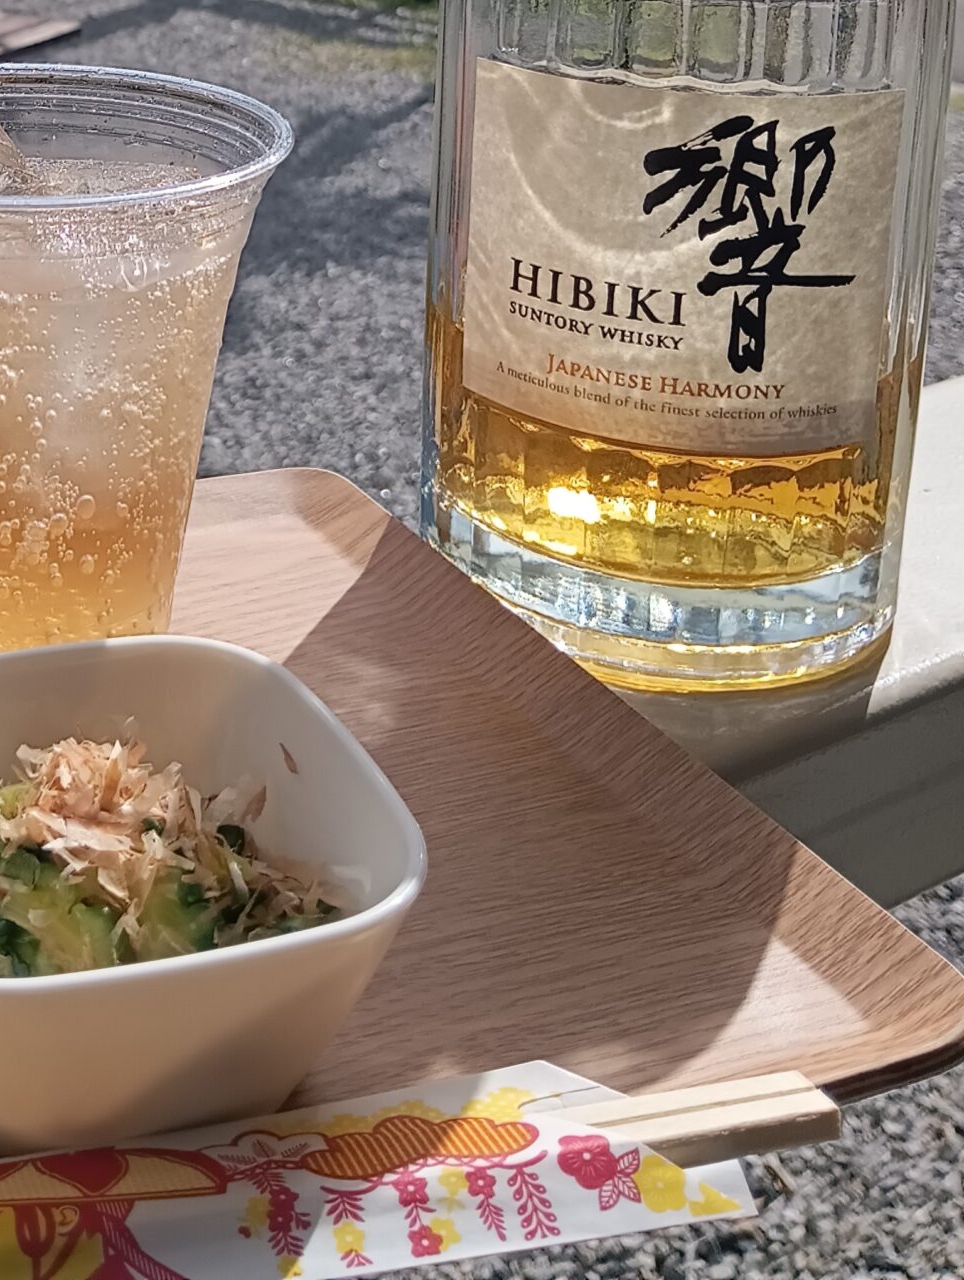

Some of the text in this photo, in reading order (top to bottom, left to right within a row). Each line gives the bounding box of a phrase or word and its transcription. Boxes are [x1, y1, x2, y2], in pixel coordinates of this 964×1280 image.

[643, 115, 856, 373] 響
[509, 257, 687, 326] HIBIKI
[509, 301, 684, 350] SUNTORY WHISKY
[496, 361, 837, 420] A meticulous blend of the finest selection of whiskies
